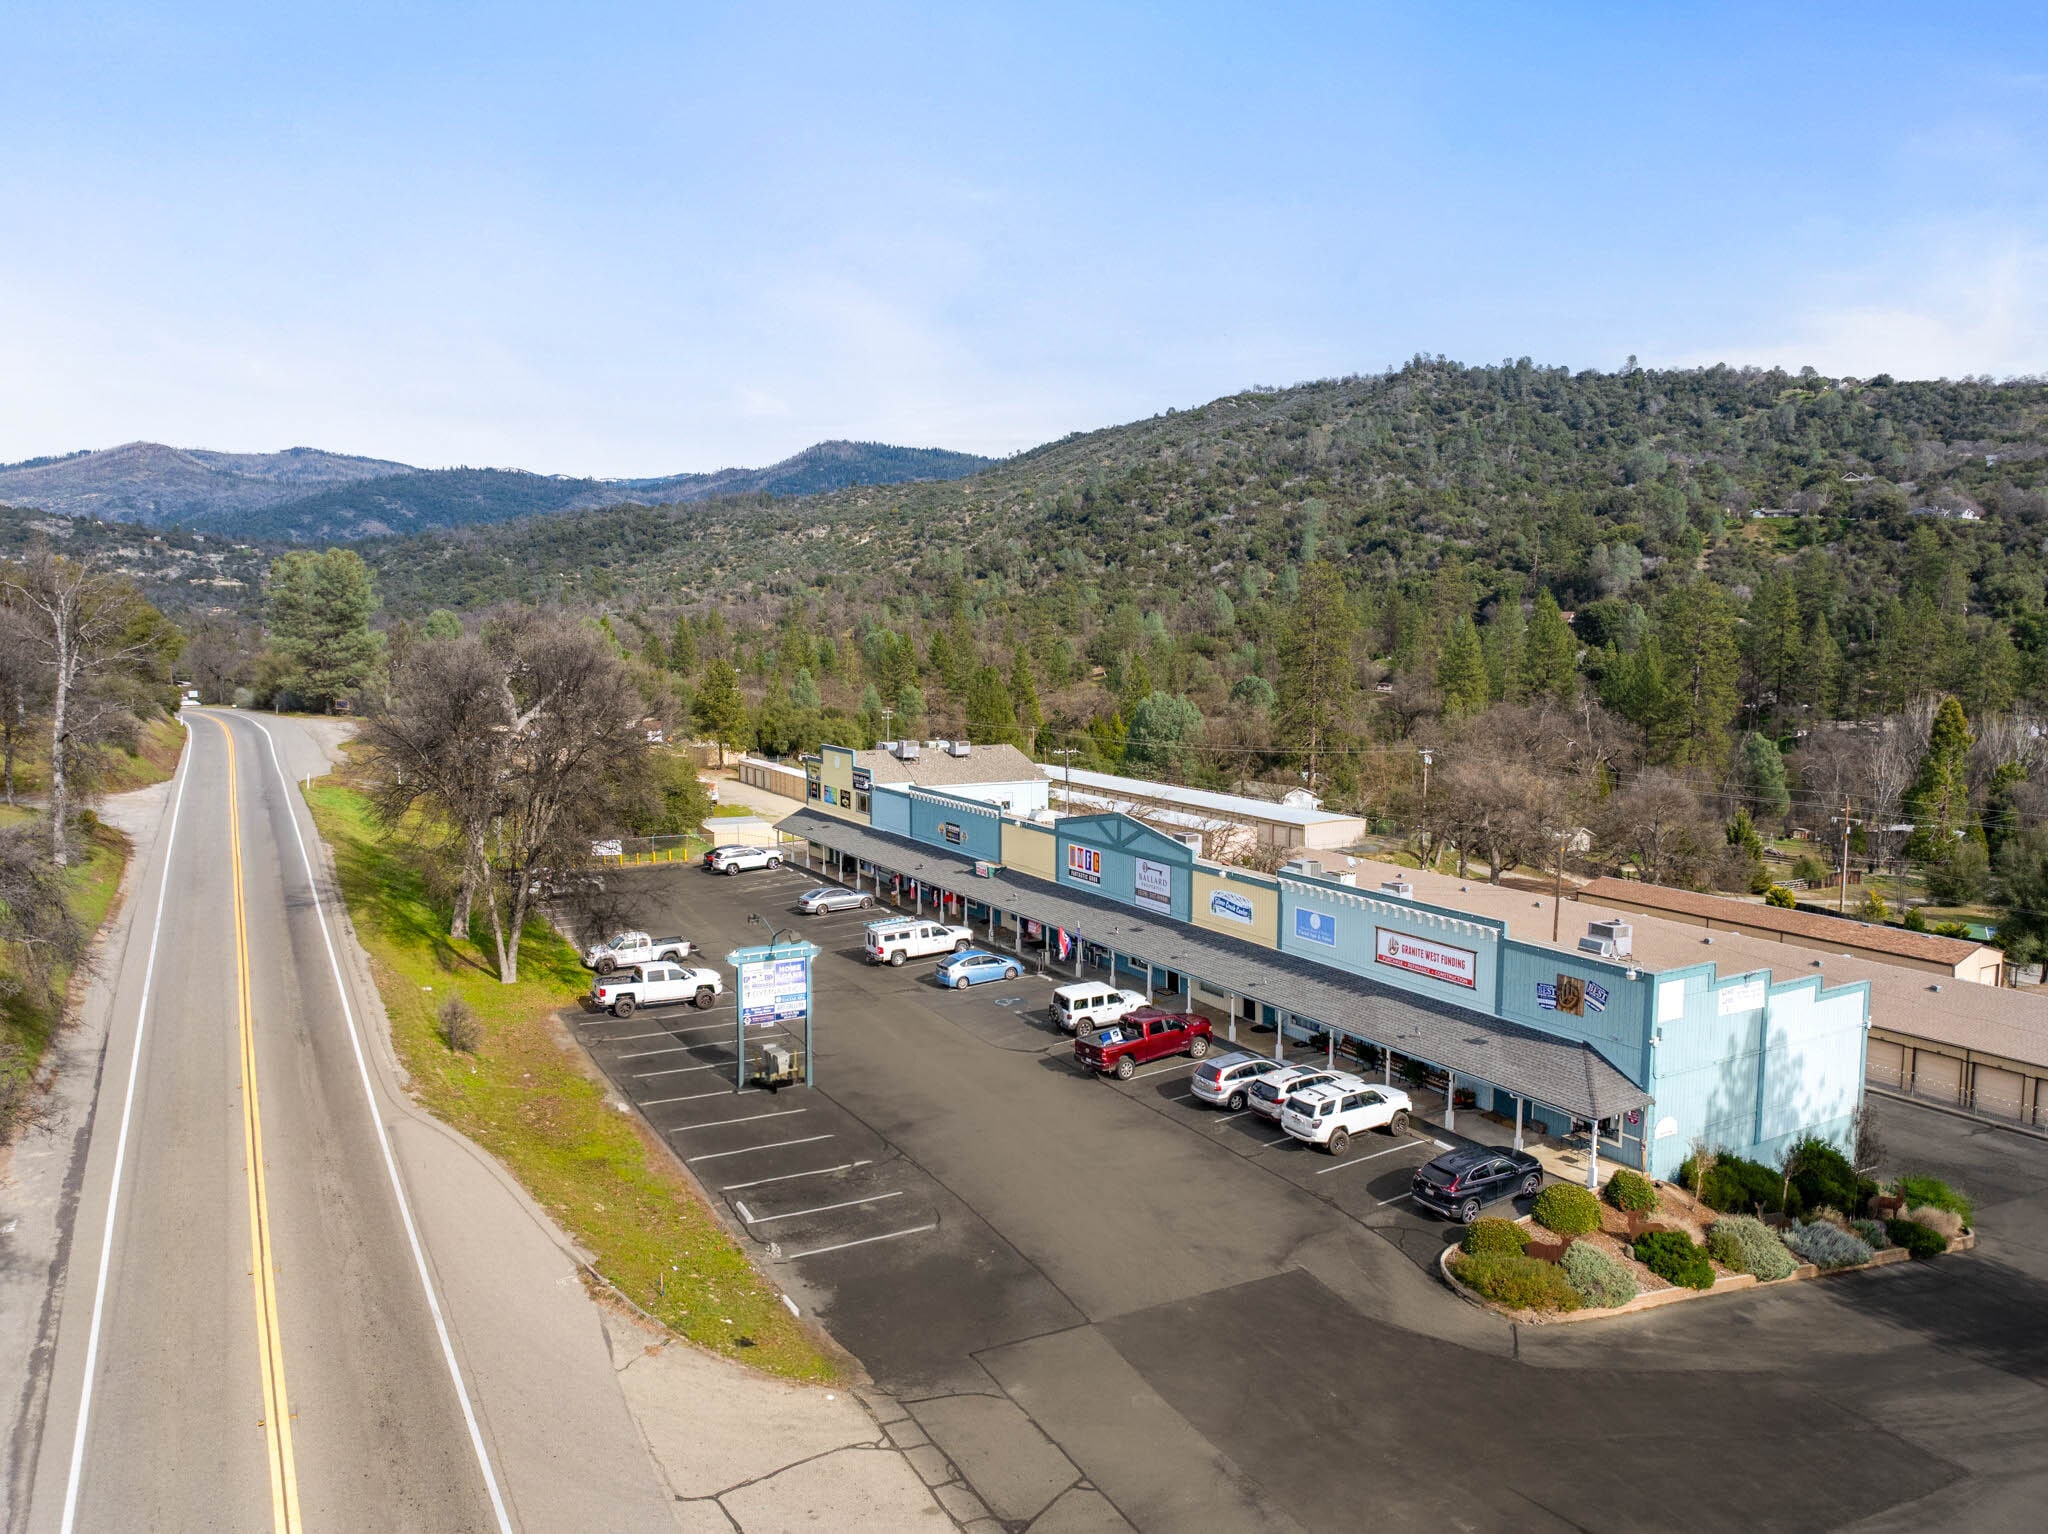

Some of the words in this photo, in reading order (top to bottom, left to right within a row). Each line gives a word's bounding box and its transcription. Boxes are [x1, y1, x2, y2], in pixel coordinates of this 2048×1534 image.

[1138, 873, 1167, 887] BALLARD
[1402, 944, 1424, 958] GRANITE
[1425, 951, 1440, 963] WEST
[1440, 954, 1466, 970] FUNDING
[1434, 970, 1468, 984] CONSTRUCTION
[1538, 986, 1556, 996] BEST
[1587, 983, 1608, 1000] BEST
